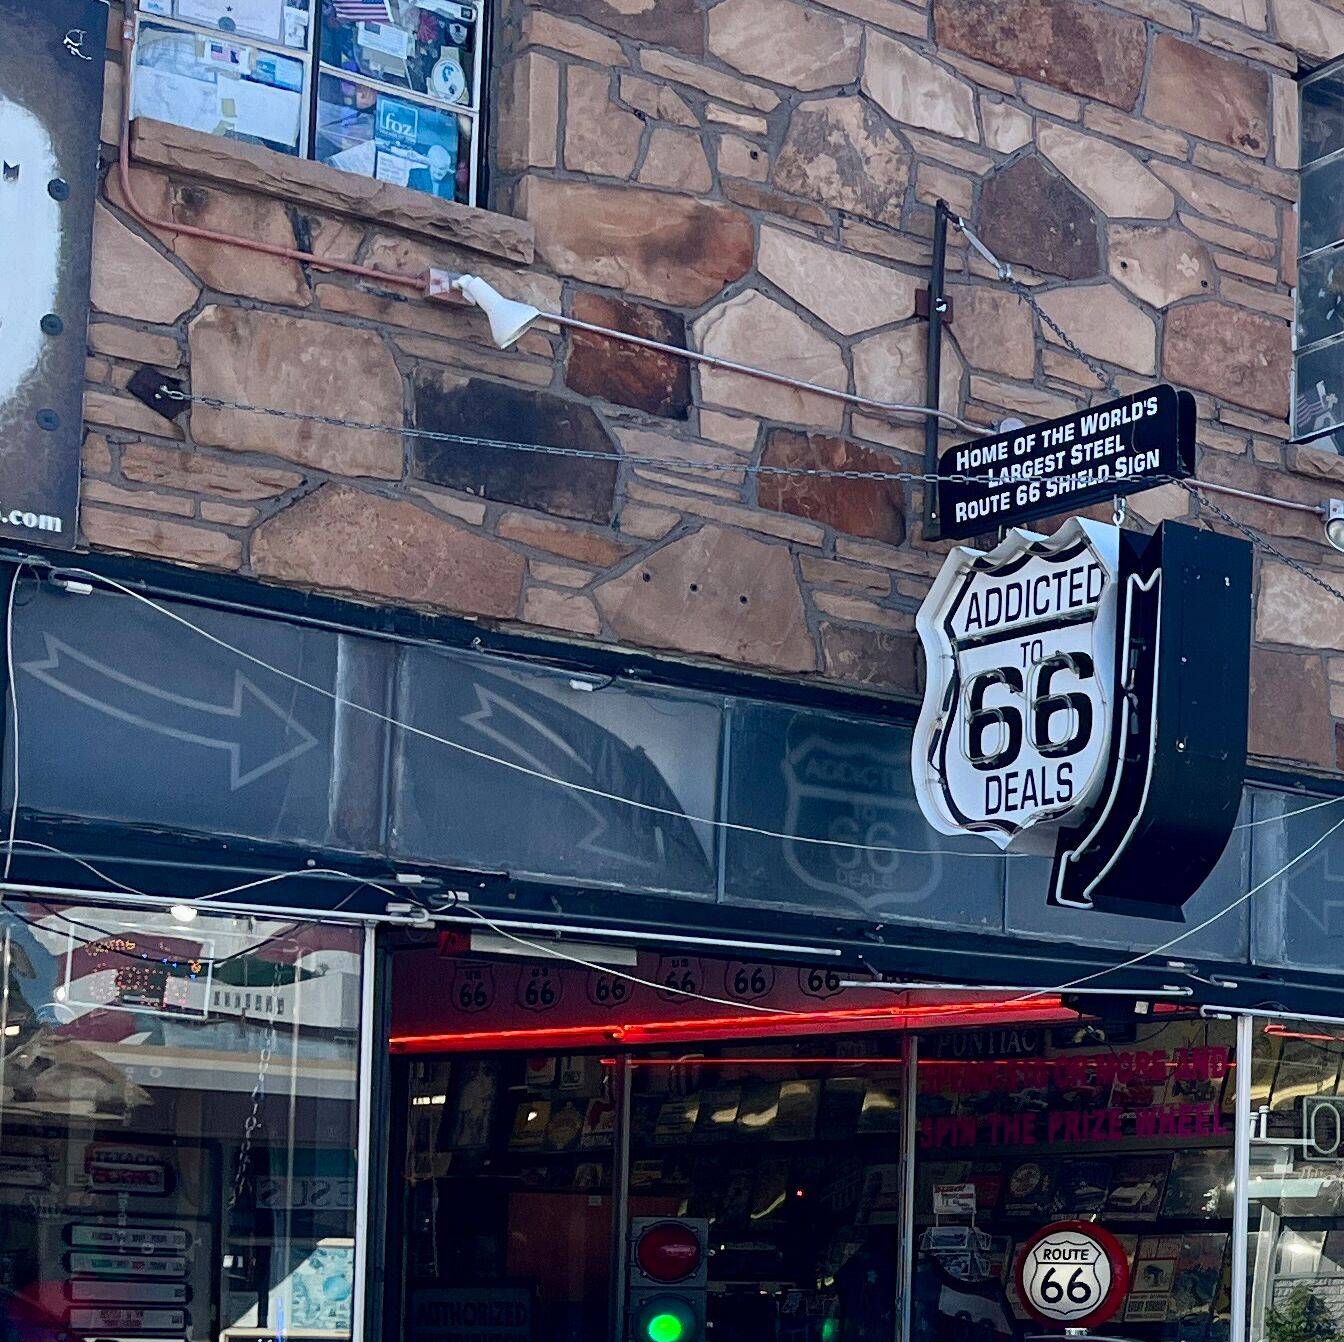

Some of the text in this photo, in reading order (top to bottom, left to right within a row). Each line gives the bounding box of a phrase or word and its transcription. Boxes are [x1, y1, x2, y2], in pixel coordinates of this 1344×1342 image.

[956, 396, 1158, 472] HOME OF THE WORLD'S
[988, 434, 1125, 489] LARGEST STEEL
[955, 448, 1160, 523] ROUTE 66 SHIELD SIGN
[964, 562, 1106, 633] ADDICTED
[1020, 639, 1043, 668] TO
[964, 651, 1094, 771] 66
[984, 761, 1074, 816] DEALS
[459, 985, 488, 1006] 66
[525, 980, 555, 1004] 66
[664, 971, 696, 996] 66
[733, 968, 766, 992] 66
[808, 968, 841, 993] 66
[987, 1110, 1038, 1146] THE
[1048, 1107, 1120, 1143] PRIZE
[1042, 1248, 1090, 1261] ROUTE
[1040, 1267, 1092, 1304] 66
